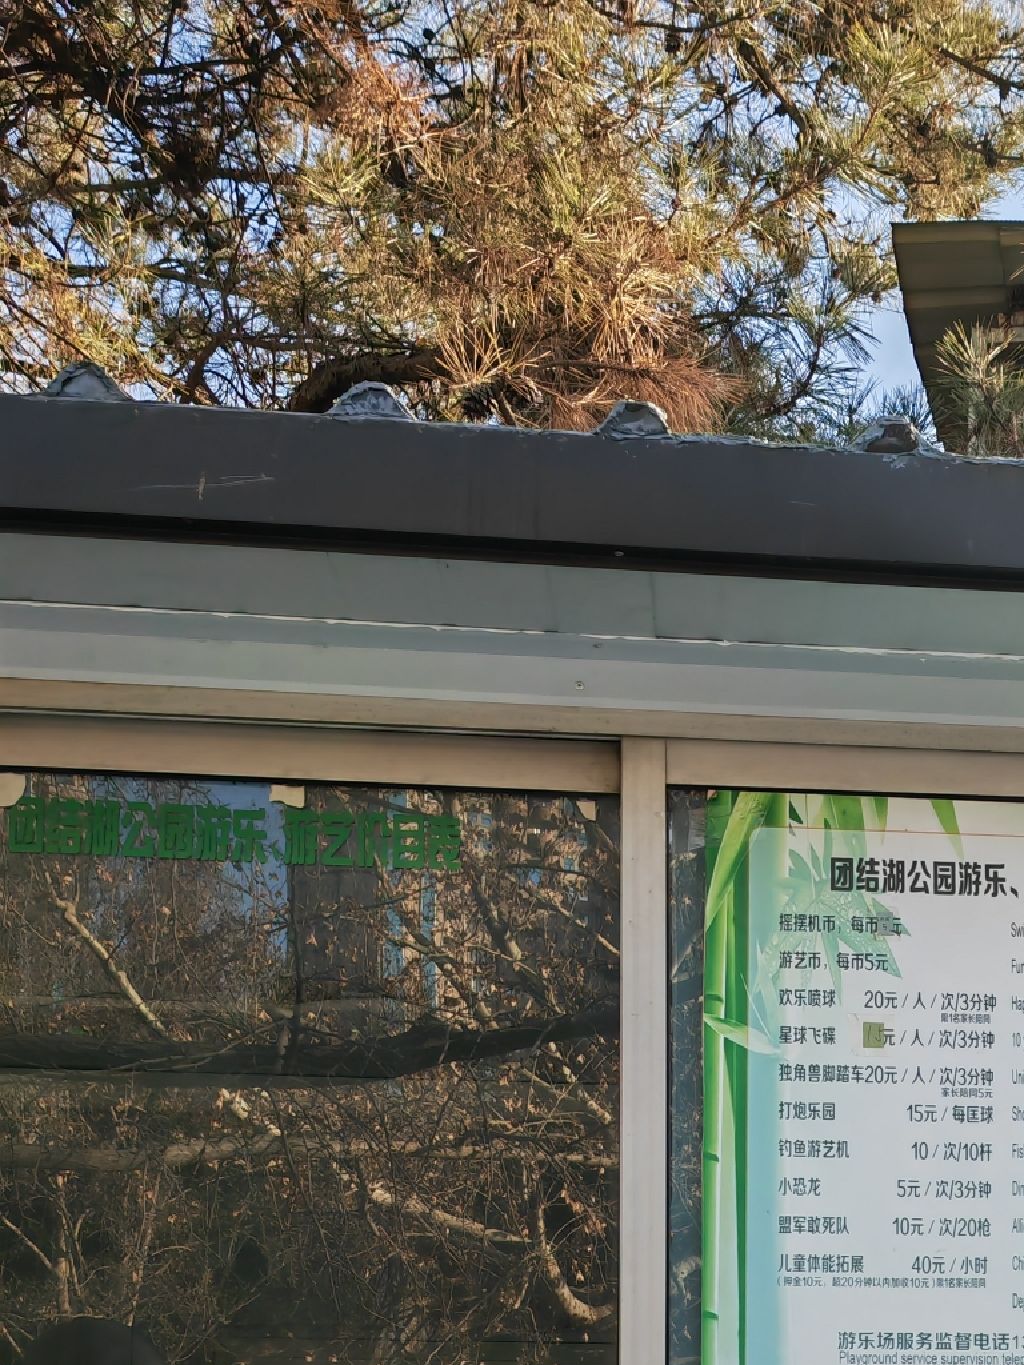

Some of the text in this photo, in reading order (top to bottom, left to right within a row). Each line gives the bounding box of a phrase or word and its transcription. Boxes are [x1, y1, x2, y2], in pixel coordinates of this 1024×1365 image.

[779, 989, 836, 1006] 欢乐喷球
[779, 1025, 836, 1045] 星球飞碟
[779, 1102, 836, 1121] 打炮乐园
[779, 1139, 849, 1159] 钓鱼游艺机
[779, 1177, 821, 1196] 小恐龙
[778, 1216, 849, 1235] 盟军敢死队
[777, 1254, 864, 1274] 儿童体能拓展
[900, 1352, 937, 1365] service
